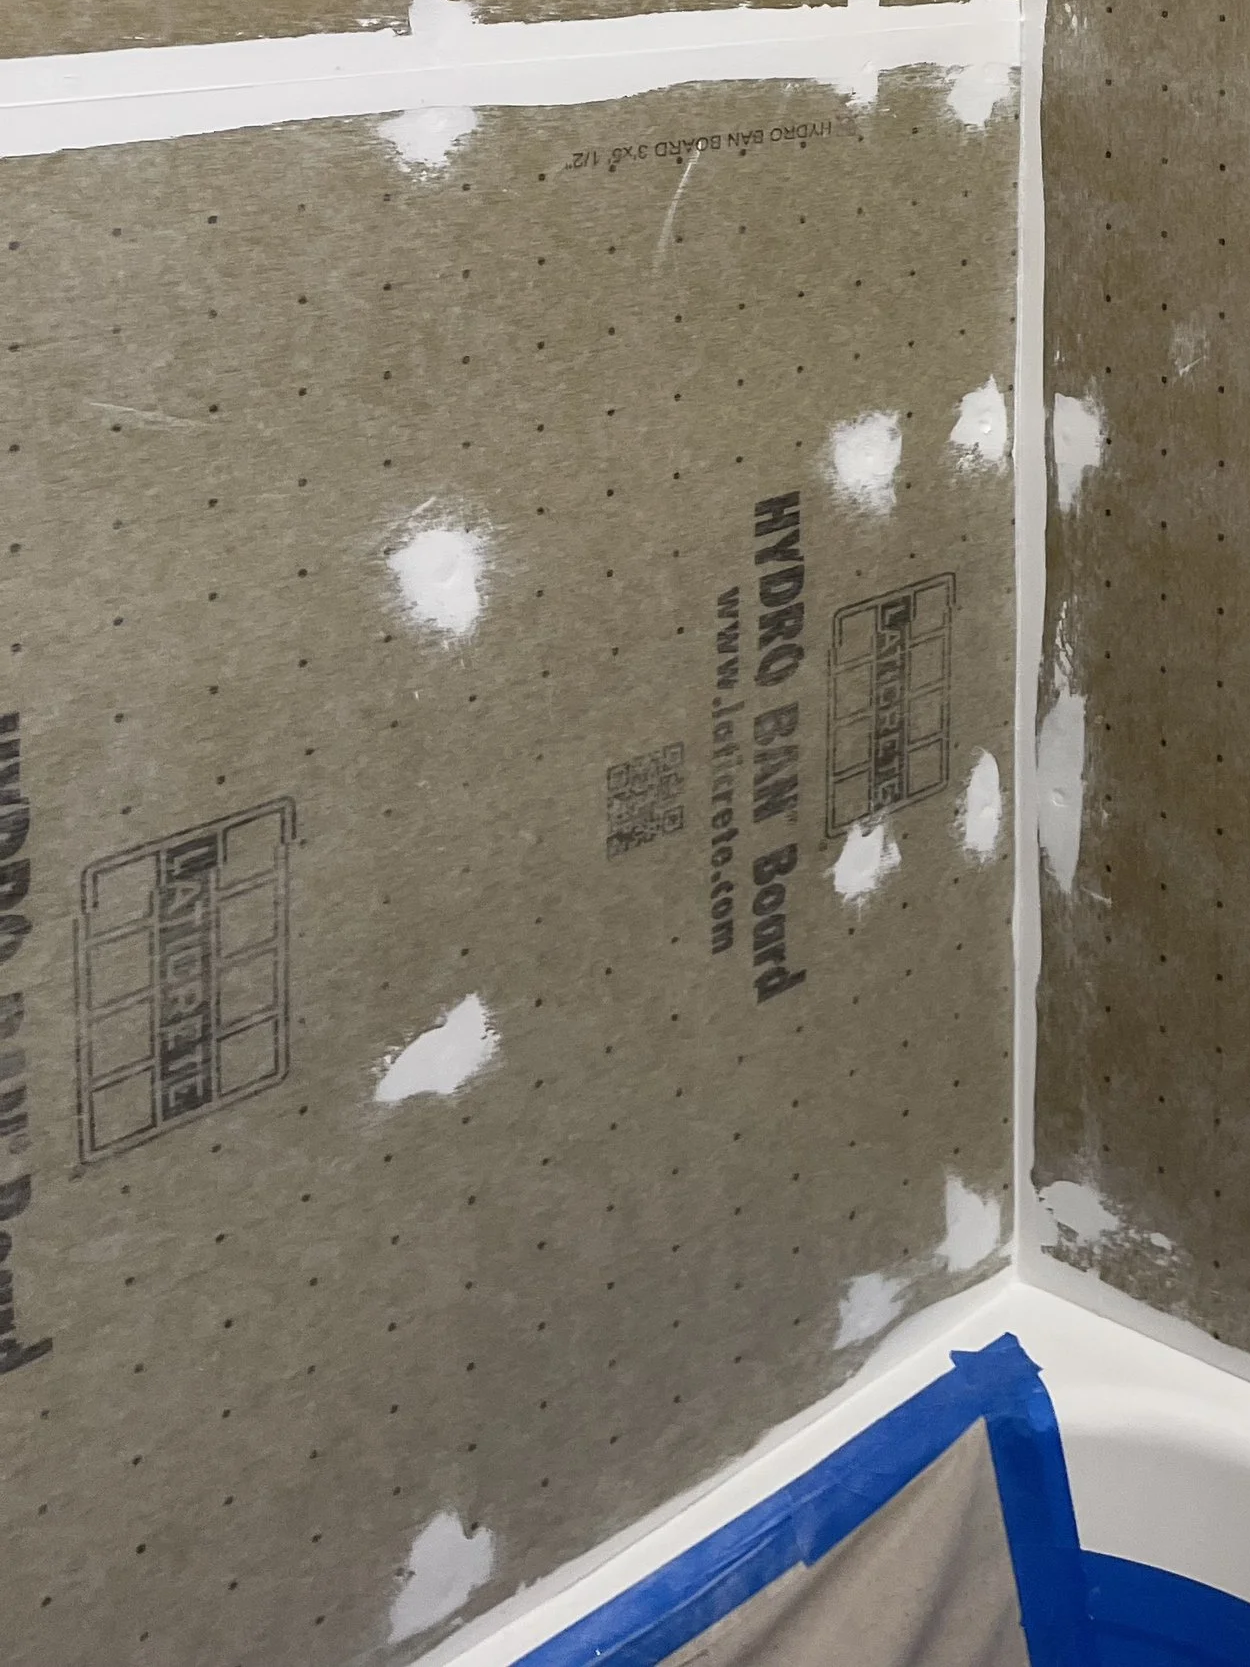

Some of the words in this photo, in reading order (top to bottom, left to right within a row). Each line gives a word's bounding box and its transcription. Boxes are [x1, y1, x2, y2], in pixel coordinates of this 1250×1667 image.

[654, 139, 722, 158] BOARD
[726, 132, 764, 150] BAN
[769, 120, 833, 143] HYDRO
[754, 491, 805, 688] HYDRO
[710, 585, 746, 956] www.laticrete.com
[752, 842, 807, 1004] Board
